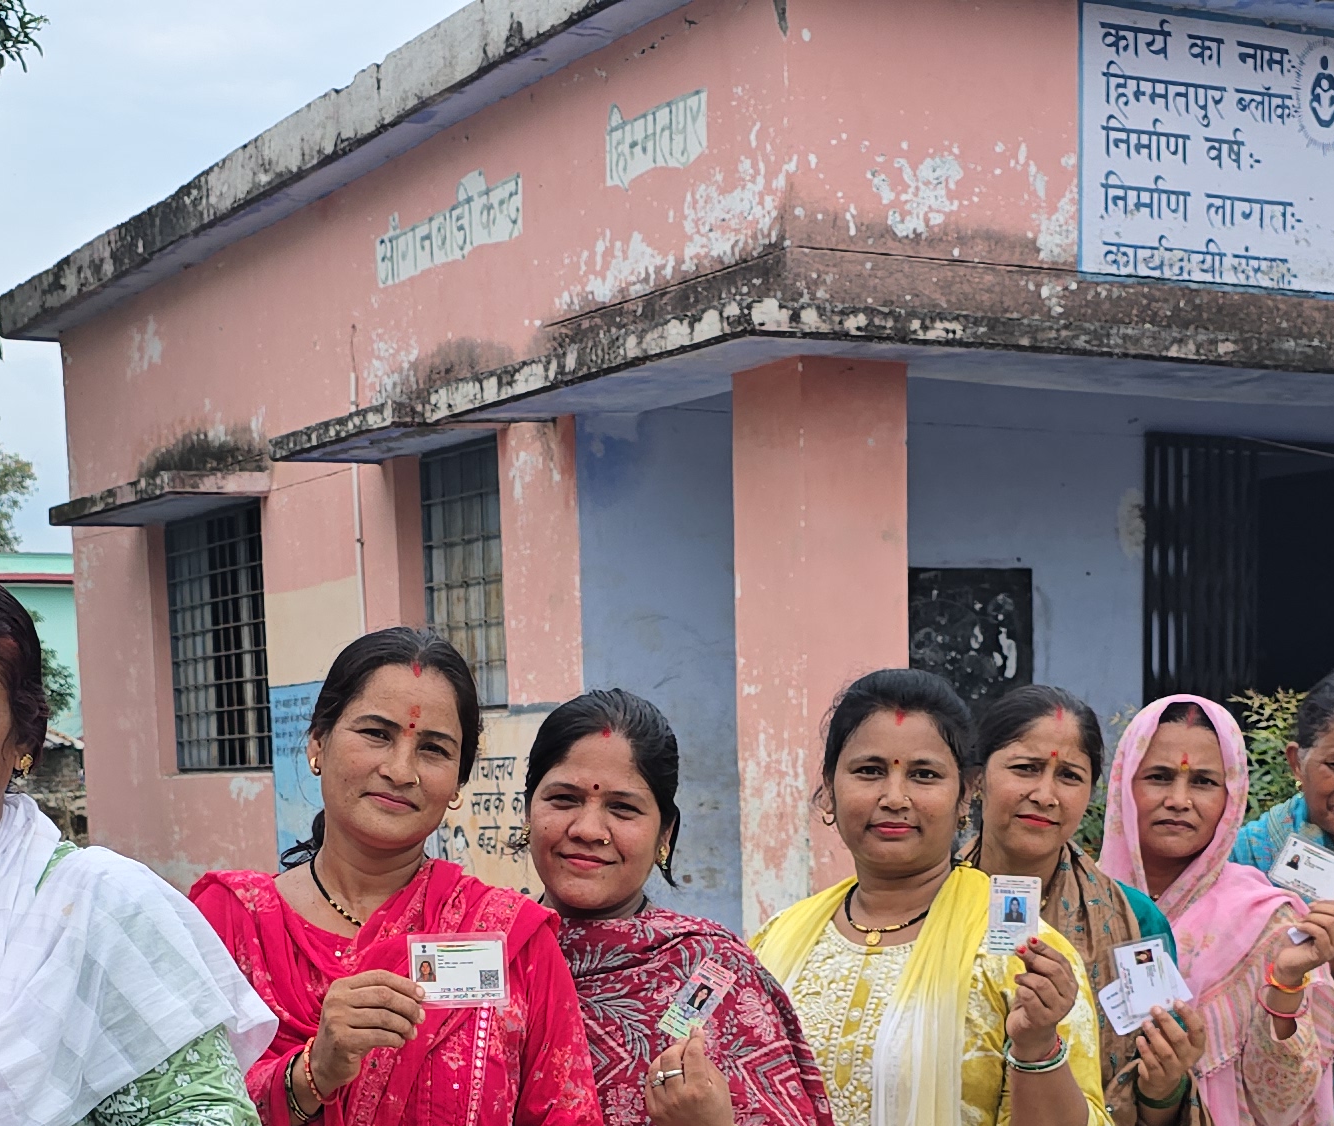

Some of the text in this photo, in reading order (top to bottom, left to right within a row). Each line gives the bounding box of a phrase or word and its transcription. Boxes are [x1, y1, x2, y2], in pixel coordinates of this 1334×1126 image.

[1098, 18, 1172, 60] कार्य
[1186, 33, 1225, 68] का
[1101, 60, 1227, 128] हिम्मतपुर
[607, 88, 707, 192] हिम्मतपुर
[1100, 114, 1191, 165] निर्माण
[1099, 169, 1191, 223] निर्माण
